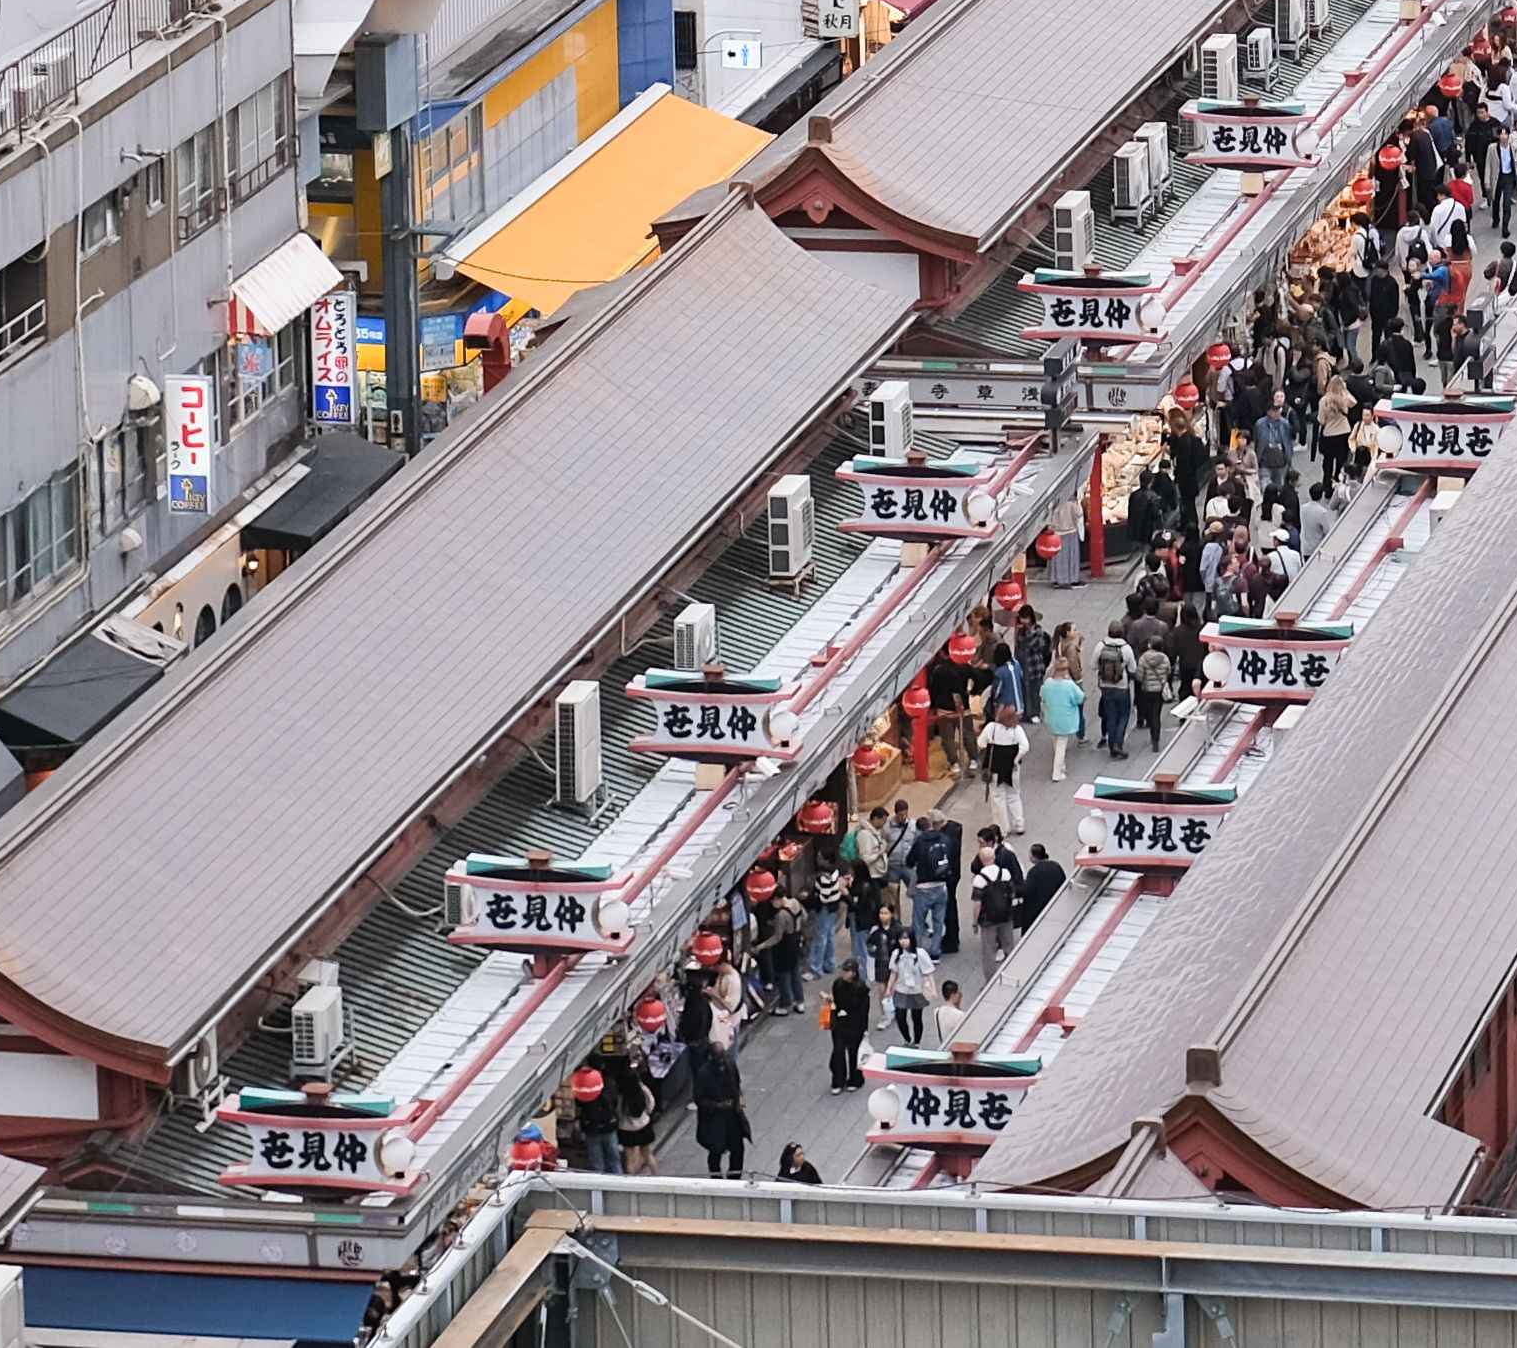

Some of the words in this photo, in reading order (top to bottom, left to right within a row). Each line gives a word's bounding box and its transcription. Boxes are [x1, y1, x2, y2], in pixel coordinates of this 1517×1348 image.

[823, 13, 852, 30] 秋月
[315, 298, 333, 383] オムライス
[333, 299, 349, 383] とろとろ卵の
[170, 441, 181, 470] ラーク
[181, 386, 205, 465] コーヒー
